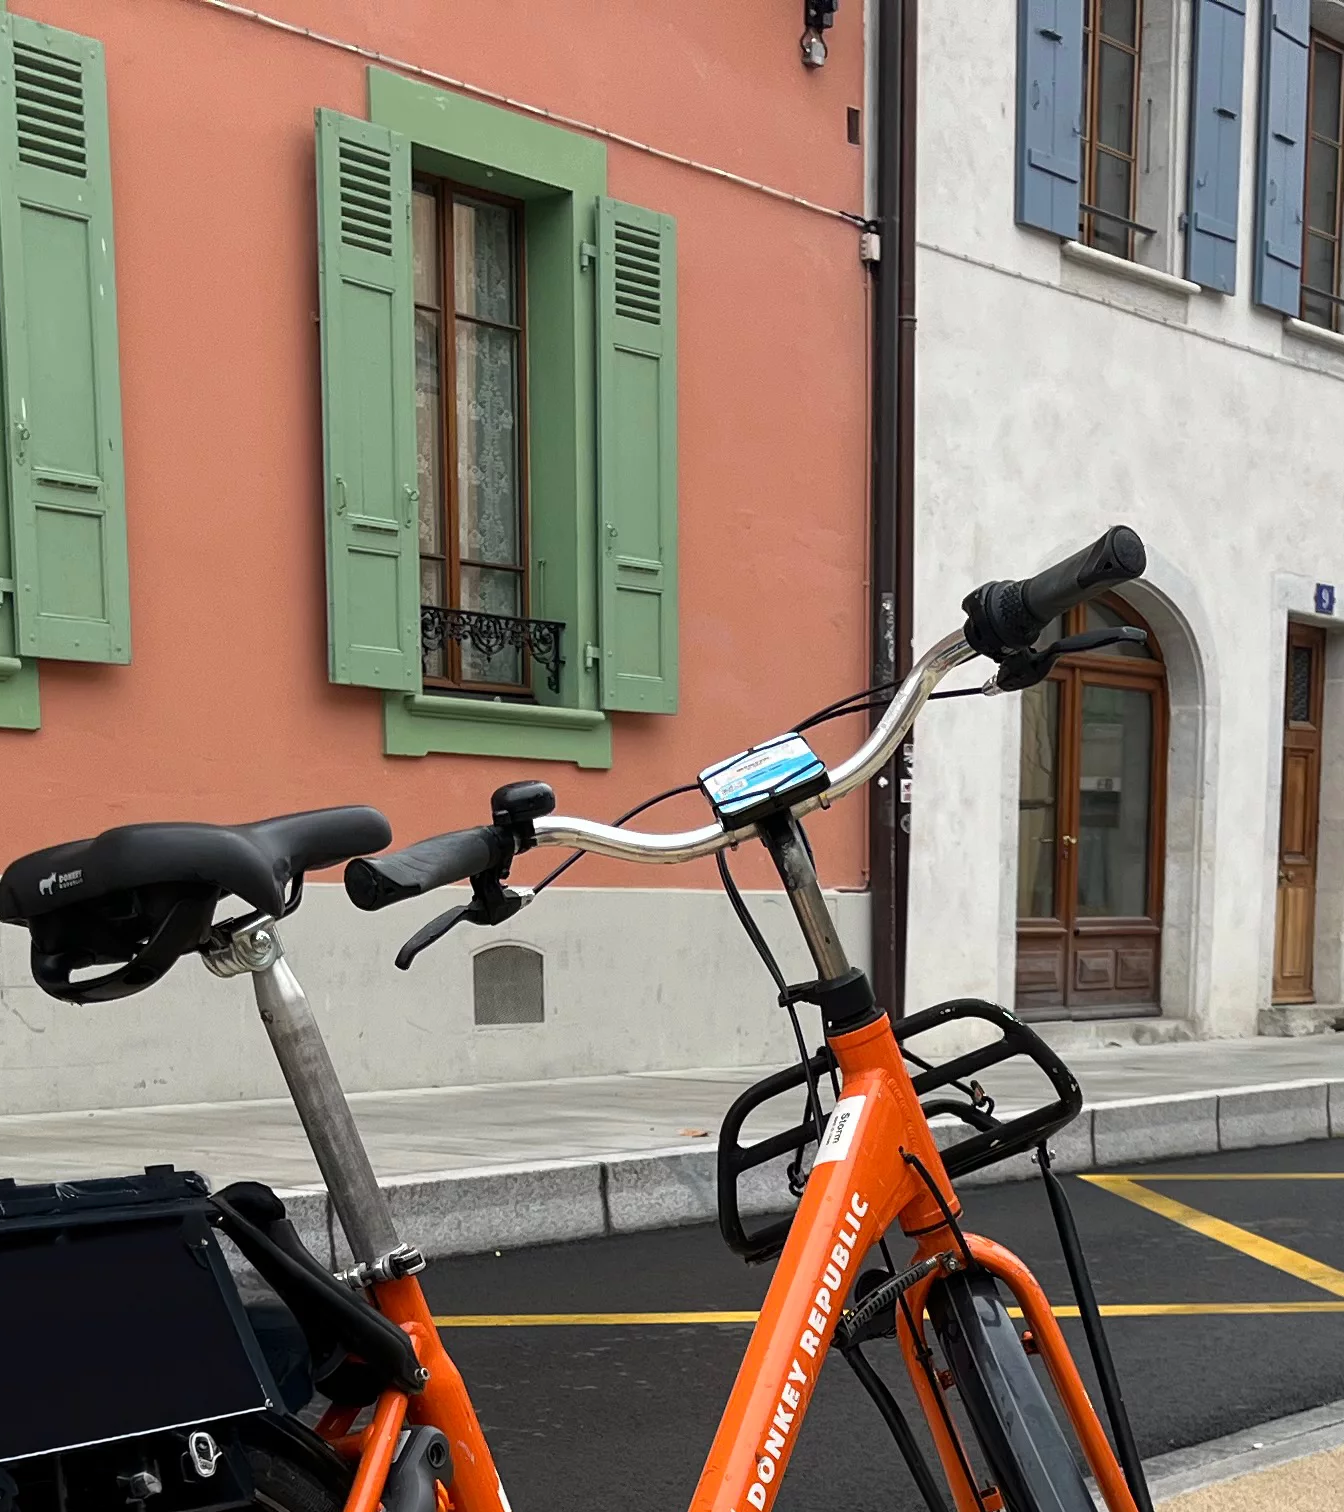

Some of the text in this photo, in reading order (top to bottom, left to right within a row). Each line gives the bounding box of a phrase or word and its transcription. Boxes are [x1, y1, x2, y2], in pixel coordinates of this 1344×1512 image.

[1321, 588, 1330, 609] 9
[832, 1112, 851, 1144] Storm
[746, 1191, 869, 1512] DONKEY REPUBLIC
